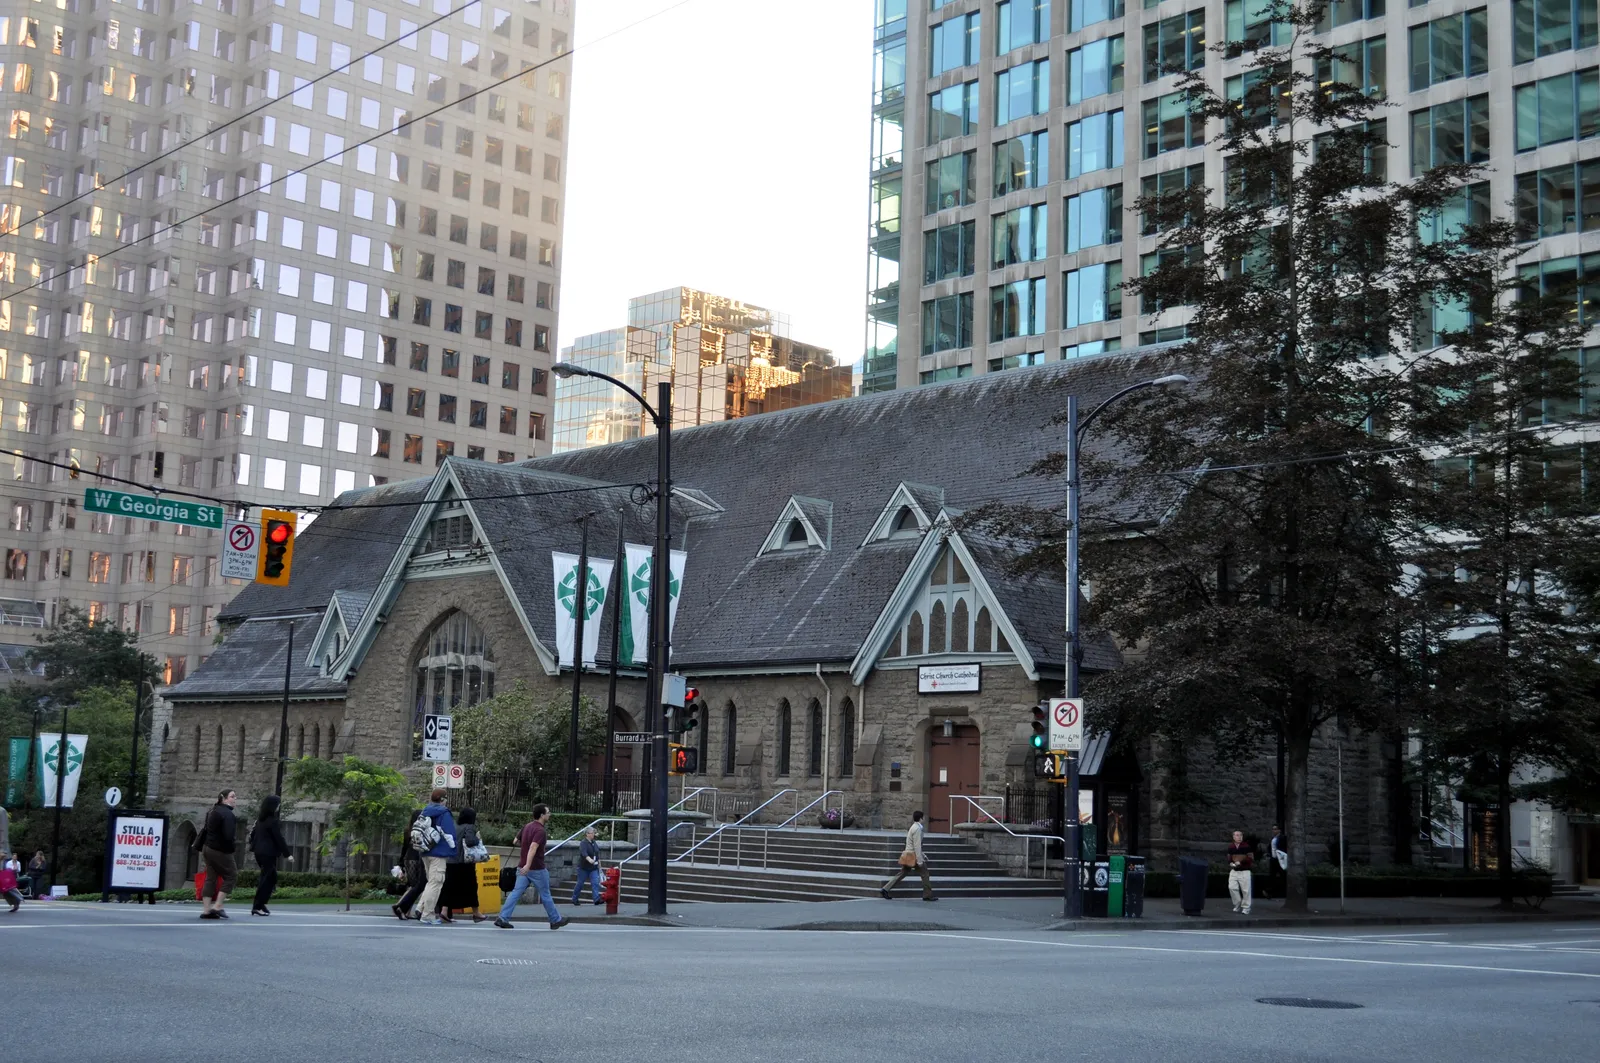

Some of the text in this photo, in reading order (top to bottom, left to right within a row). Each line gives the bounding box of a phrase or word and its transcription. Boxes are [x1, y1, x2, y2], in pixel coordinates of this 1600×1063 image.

[94, 491, 216, 522] W Georgia St
[920, 670, 979, 680] Christ Church Cathedral
[616, 734, 639, 742] Burrard
[122, 825, 154, 835] STILL A
[117, 834, 161, 846] VIRGIN?
